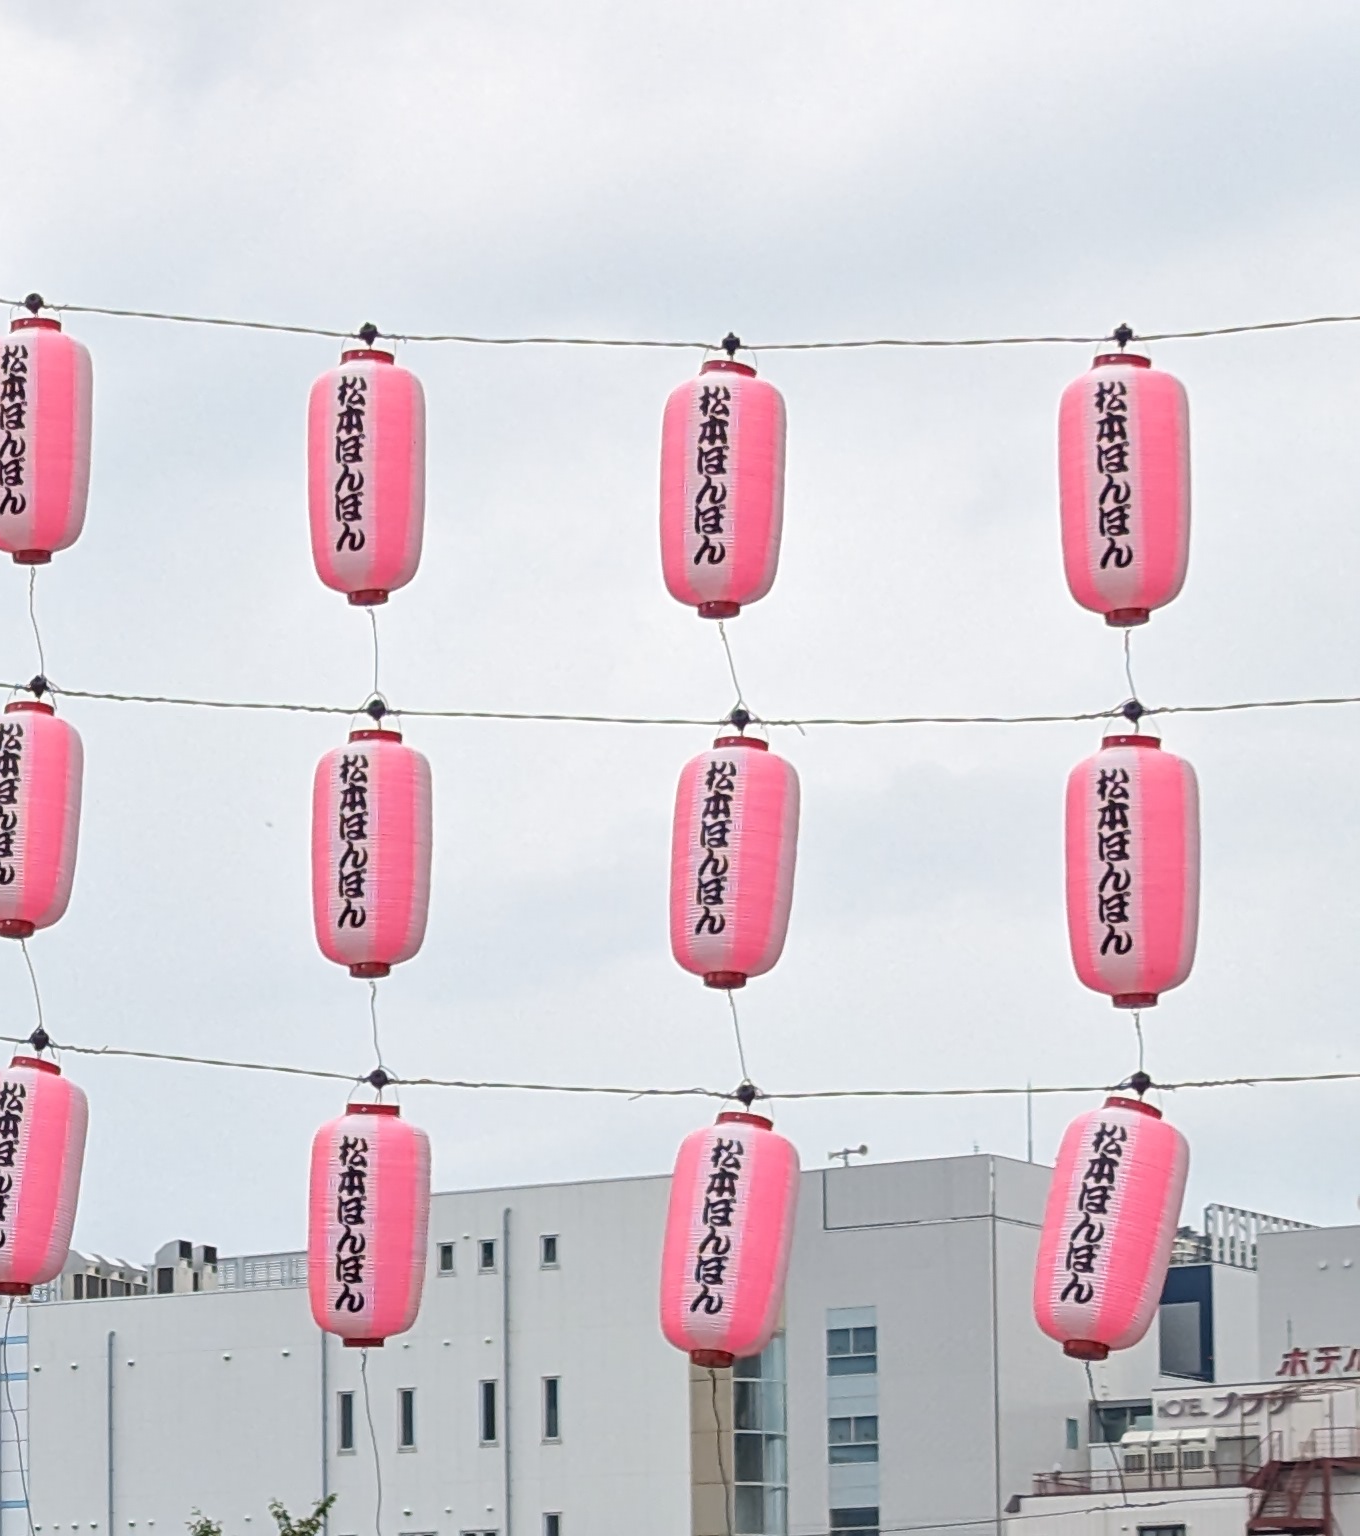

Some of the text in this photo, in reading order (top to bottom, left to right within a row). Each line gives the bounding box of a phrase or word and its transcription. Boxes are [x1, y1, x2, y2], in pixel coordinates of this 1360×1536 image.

[335, 376, 367, 552] 松本ぼんぼん
[693, 386, 731, 566] 松本ぼんぼん
[1095, 381, 1134, 570] 松本ぼんぼん
[337, 754, 369, 929] 松本ぼんぼん
[694, 761, 737, 936] 松本ぼんぼん
[1097, 768, 1133, 956] 松本ぼんぼん
[334, 1135, 369, 1314] 松本ぼんぼん
[689, 1138, 744, 1315] 松本ぼんぼん
[1060, 1122, 1127, 1305] 松本ぼんぼん
